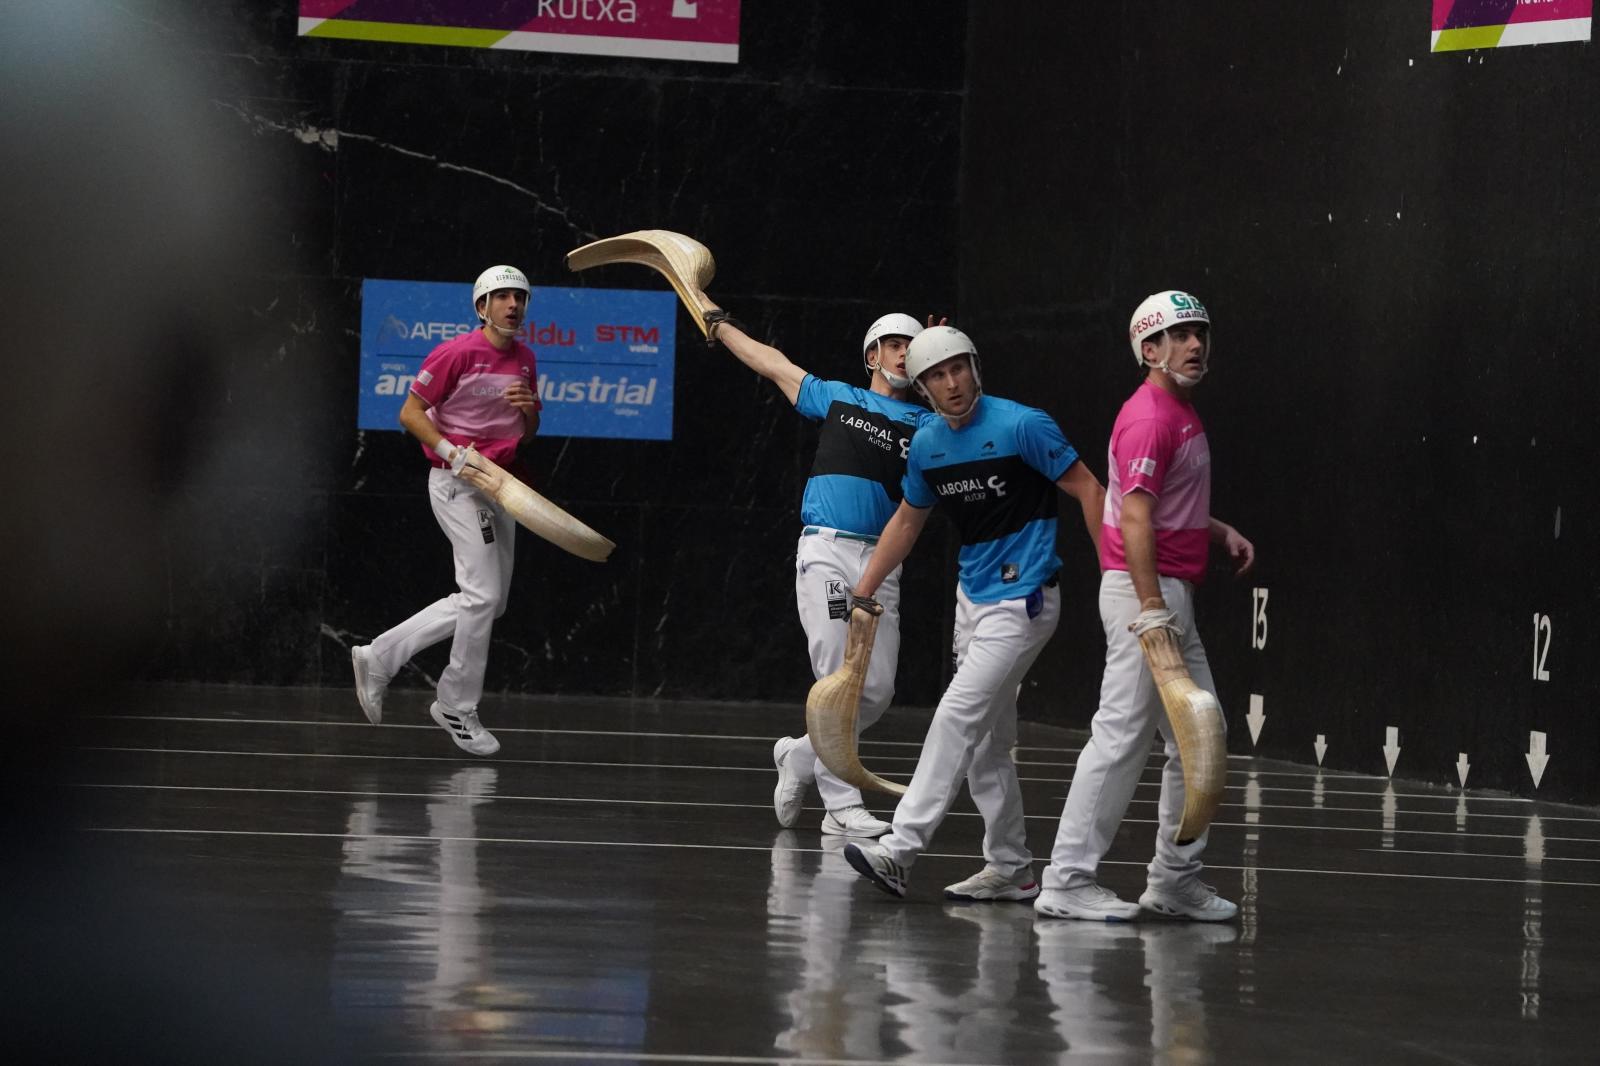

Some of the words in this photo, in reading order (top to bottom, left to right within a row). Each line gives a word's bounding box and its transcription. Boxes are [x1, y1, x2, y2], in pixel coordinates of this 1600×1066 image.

[595, 324, 660, 344] STM
[536, 373, 657, 406] ustrial
[840, 414, 893, 442] LABORAL
[936, 478, 984, 496] LABORAL
[1252, 587, 1269, 651] 13
[1533, 612, 1552, 682] 12
